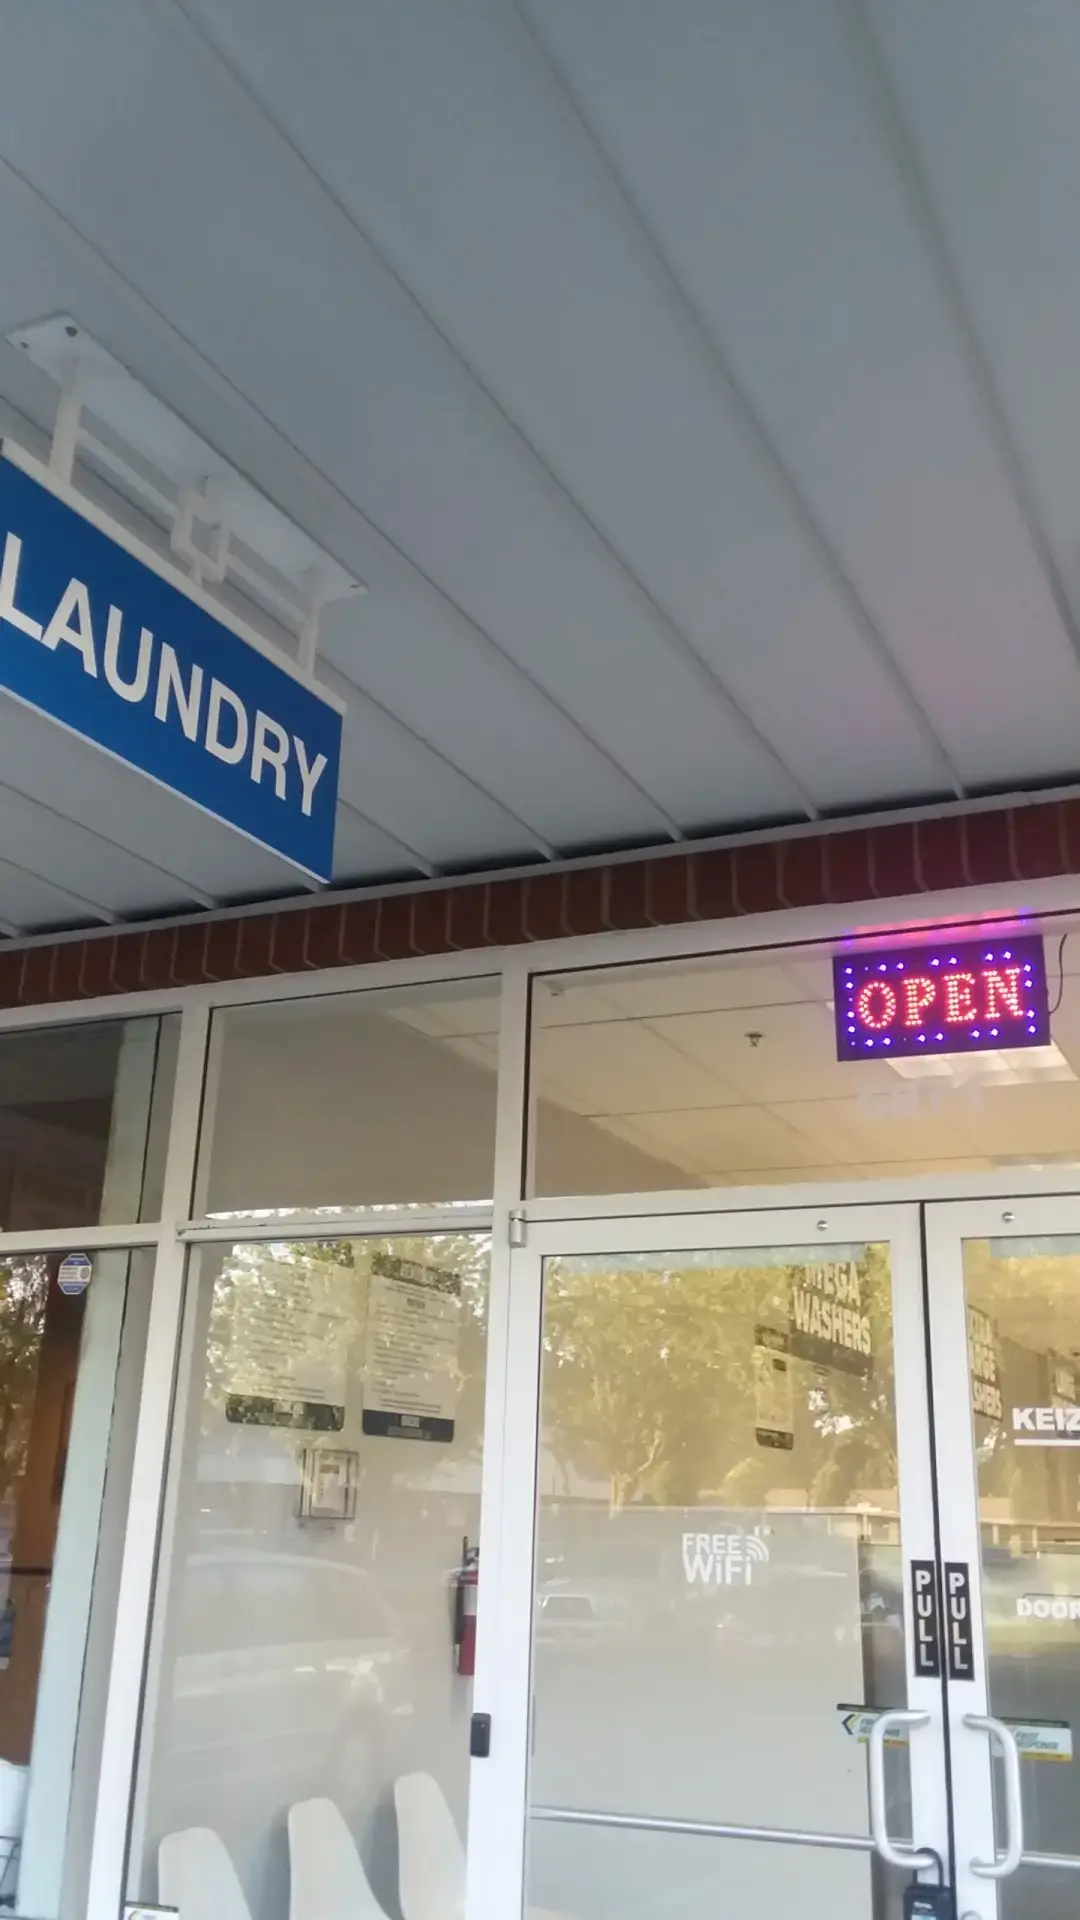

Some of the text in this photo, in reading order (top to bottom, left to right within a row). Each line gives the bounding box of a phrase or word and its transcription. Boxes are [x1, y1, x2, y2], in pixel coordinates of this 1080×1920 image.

[0, 531, 328, 817] LAUNDRY
[858, 966, 1025, 1029] OPEN
[792, 1286, 871, 1356] WASHERS
[682, 1533, 742, 1555] FREE
[915, 1569, 934, 1667] PULL
[949, 1572, 968, 1670] PULL
